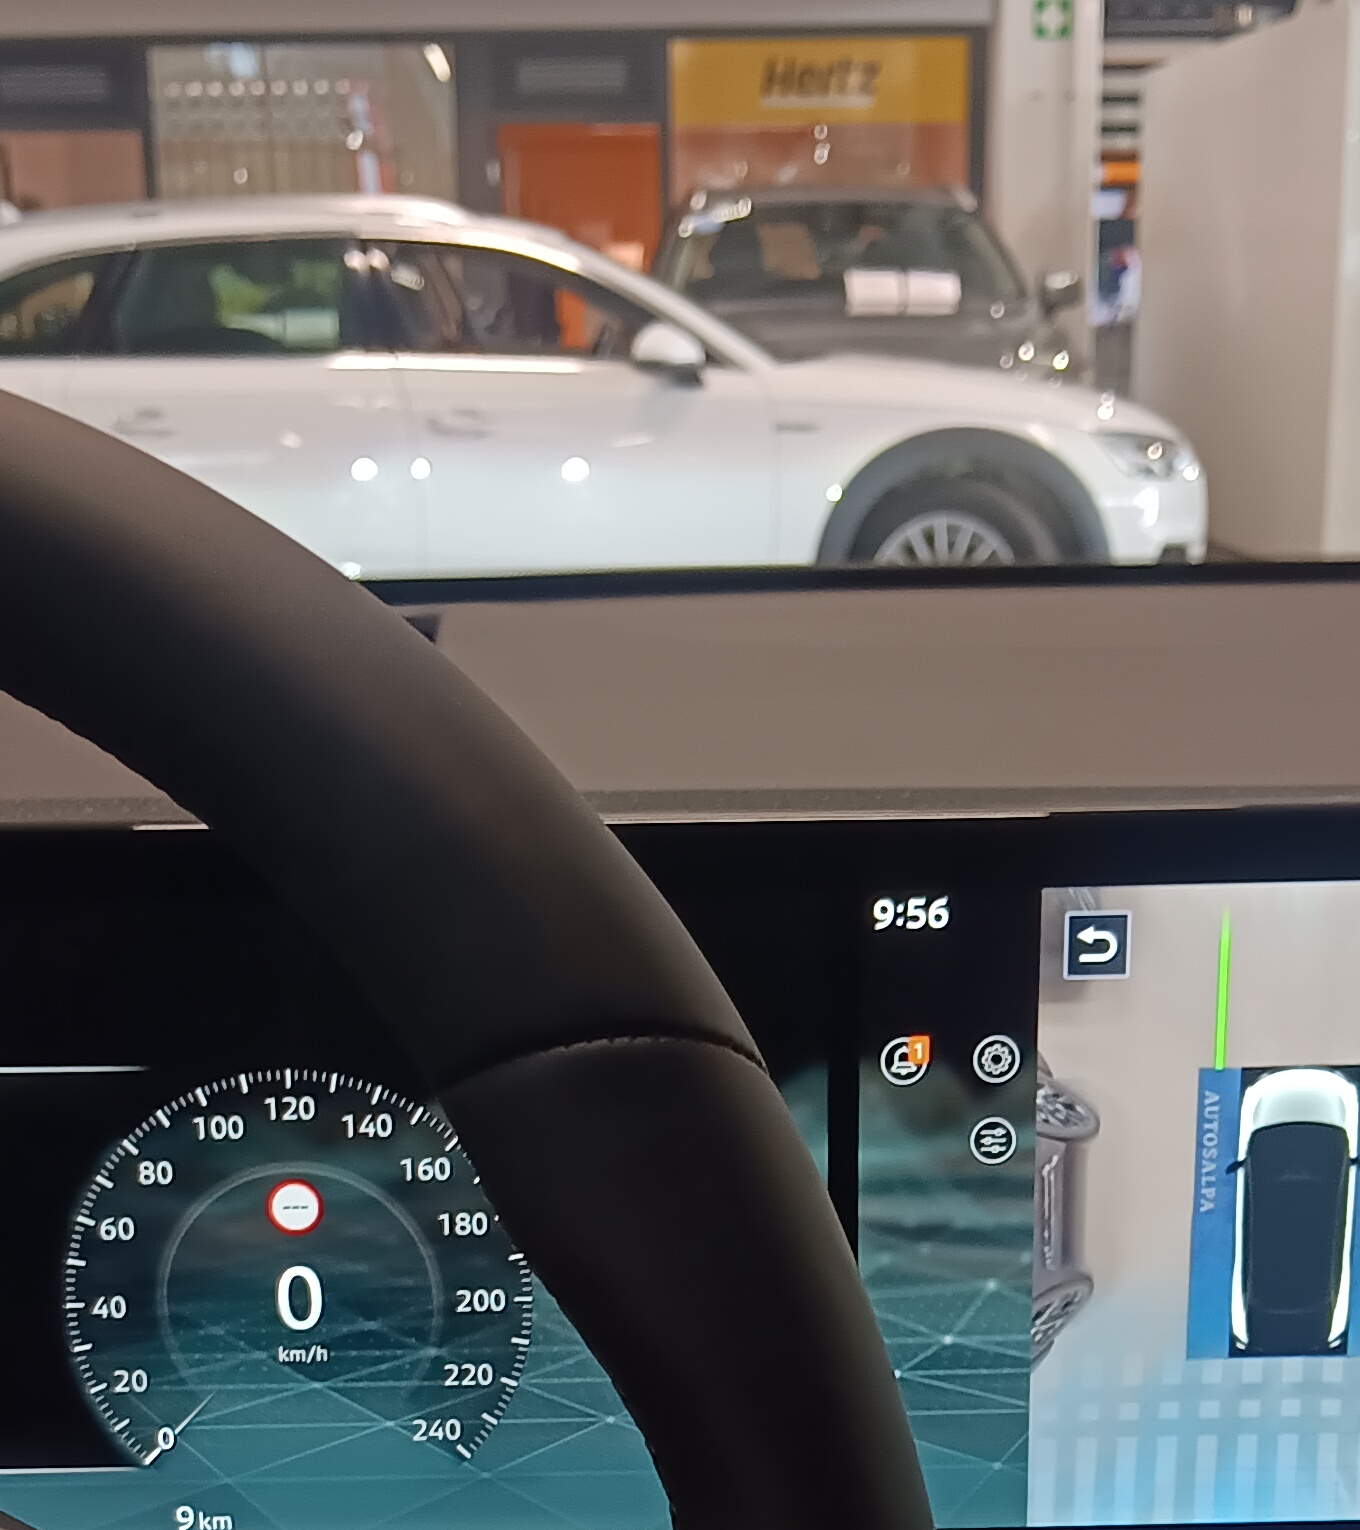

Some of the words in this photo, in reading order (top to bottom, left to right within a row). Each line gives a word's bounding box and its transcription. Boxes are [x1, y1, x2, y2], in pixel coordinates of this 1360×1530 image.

[761, 56, 882, 98] Hertz
[873, 896, 950, 930] 9:56
[264, 1096, 315, 1121] 120
[193, 1114, 244, 1140] 100
[342, 1113, 393, 1138] 140
[1200, 1090, 1220, 1213] AUTOSALPA
[138, 1161, 173, 1185] 80
[400, 1157, 451, 1182] 160
[100, 1217, 135, 1241] 60
[438, 1211, 488, 1236] 180
[92, 1296, 127, 1319] 40
[277, 1266, 323, 1330] 0
[456, 1288, 506, 1313] 200
[278, 1344, 328, 1364] km/h
[113, 1370, 148, 1393] 20
[443, 1364, 493, 1387] 220
[158, 1426, 174, 1450] 0
[412, 1418, 462, 1443] 240
